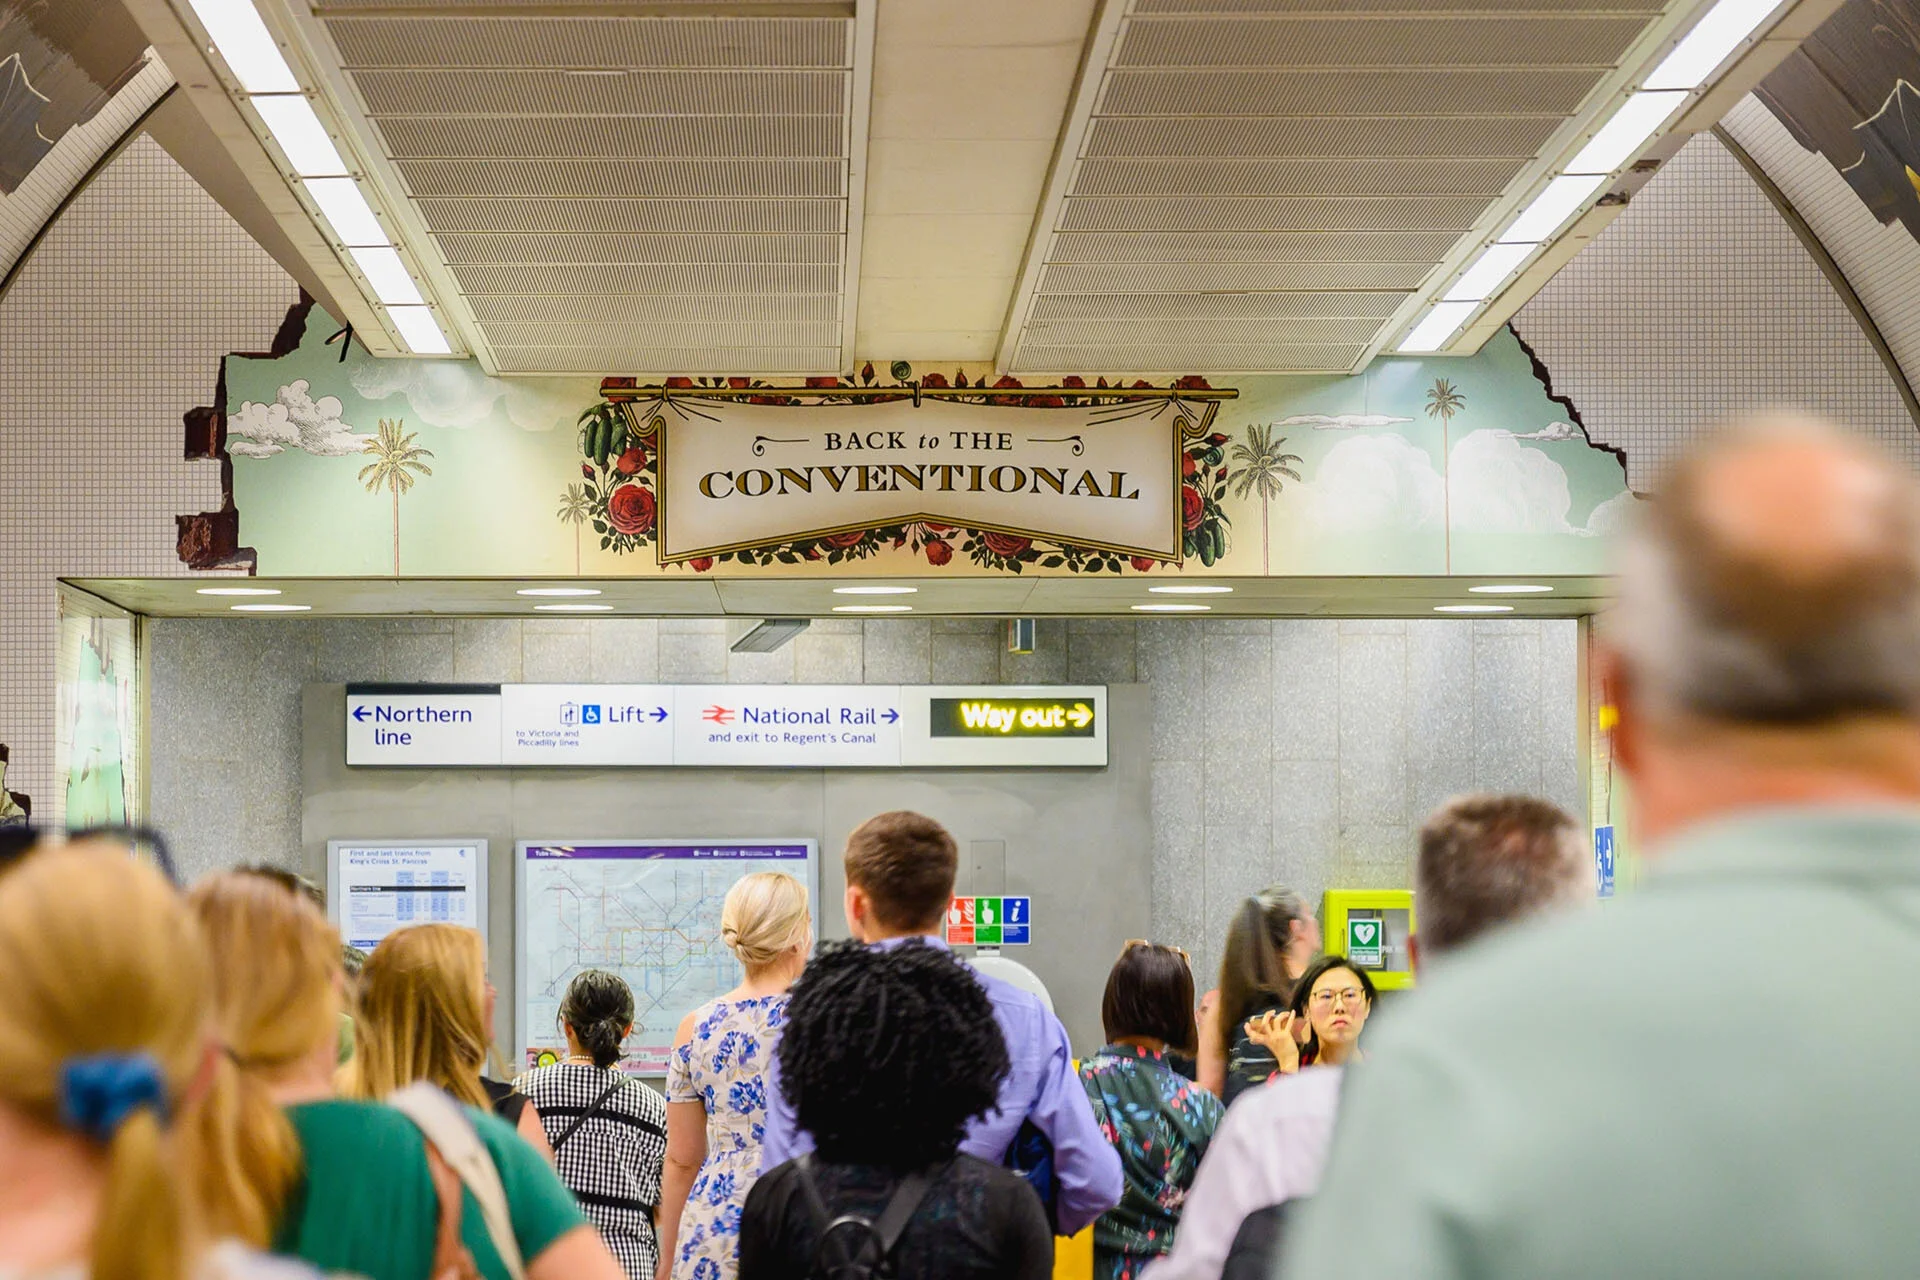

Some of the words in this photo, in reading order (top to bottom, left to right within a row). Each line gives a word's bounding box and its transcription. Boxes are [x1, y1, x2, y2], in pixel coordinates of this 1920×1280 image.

[825, 431, 907, 451] BACK
[918, 434, 940, 449] to
[950, 431, 1013, 451] THE
[698, 464, 1140, 500] CONVENTIONAL
[375, 705, 472, 723] Northern
[609, 706, 645, 723] Lift
[743, 707, 831, 724] National
[840, 707, 876, 724] Rail
[960, 702, 1017, 733] Way
[1020, 704, 1066, 728] out
[374, 728, 412, 746] line
[516, 730, 525, 738] to
[528, 730, 561, 738] Victoria
[564, 730, 580, 738] and
[708, 731, 731, 743] and
[735, 732, 759, 743] exit
[764, 732, 779, 743] to
[783, 731, 837, 745] Regent's
[841, 731, 876, 743] Canal
[518, 738, 557, 748] Piccadilly
[559, 739, 579, 747] lines
